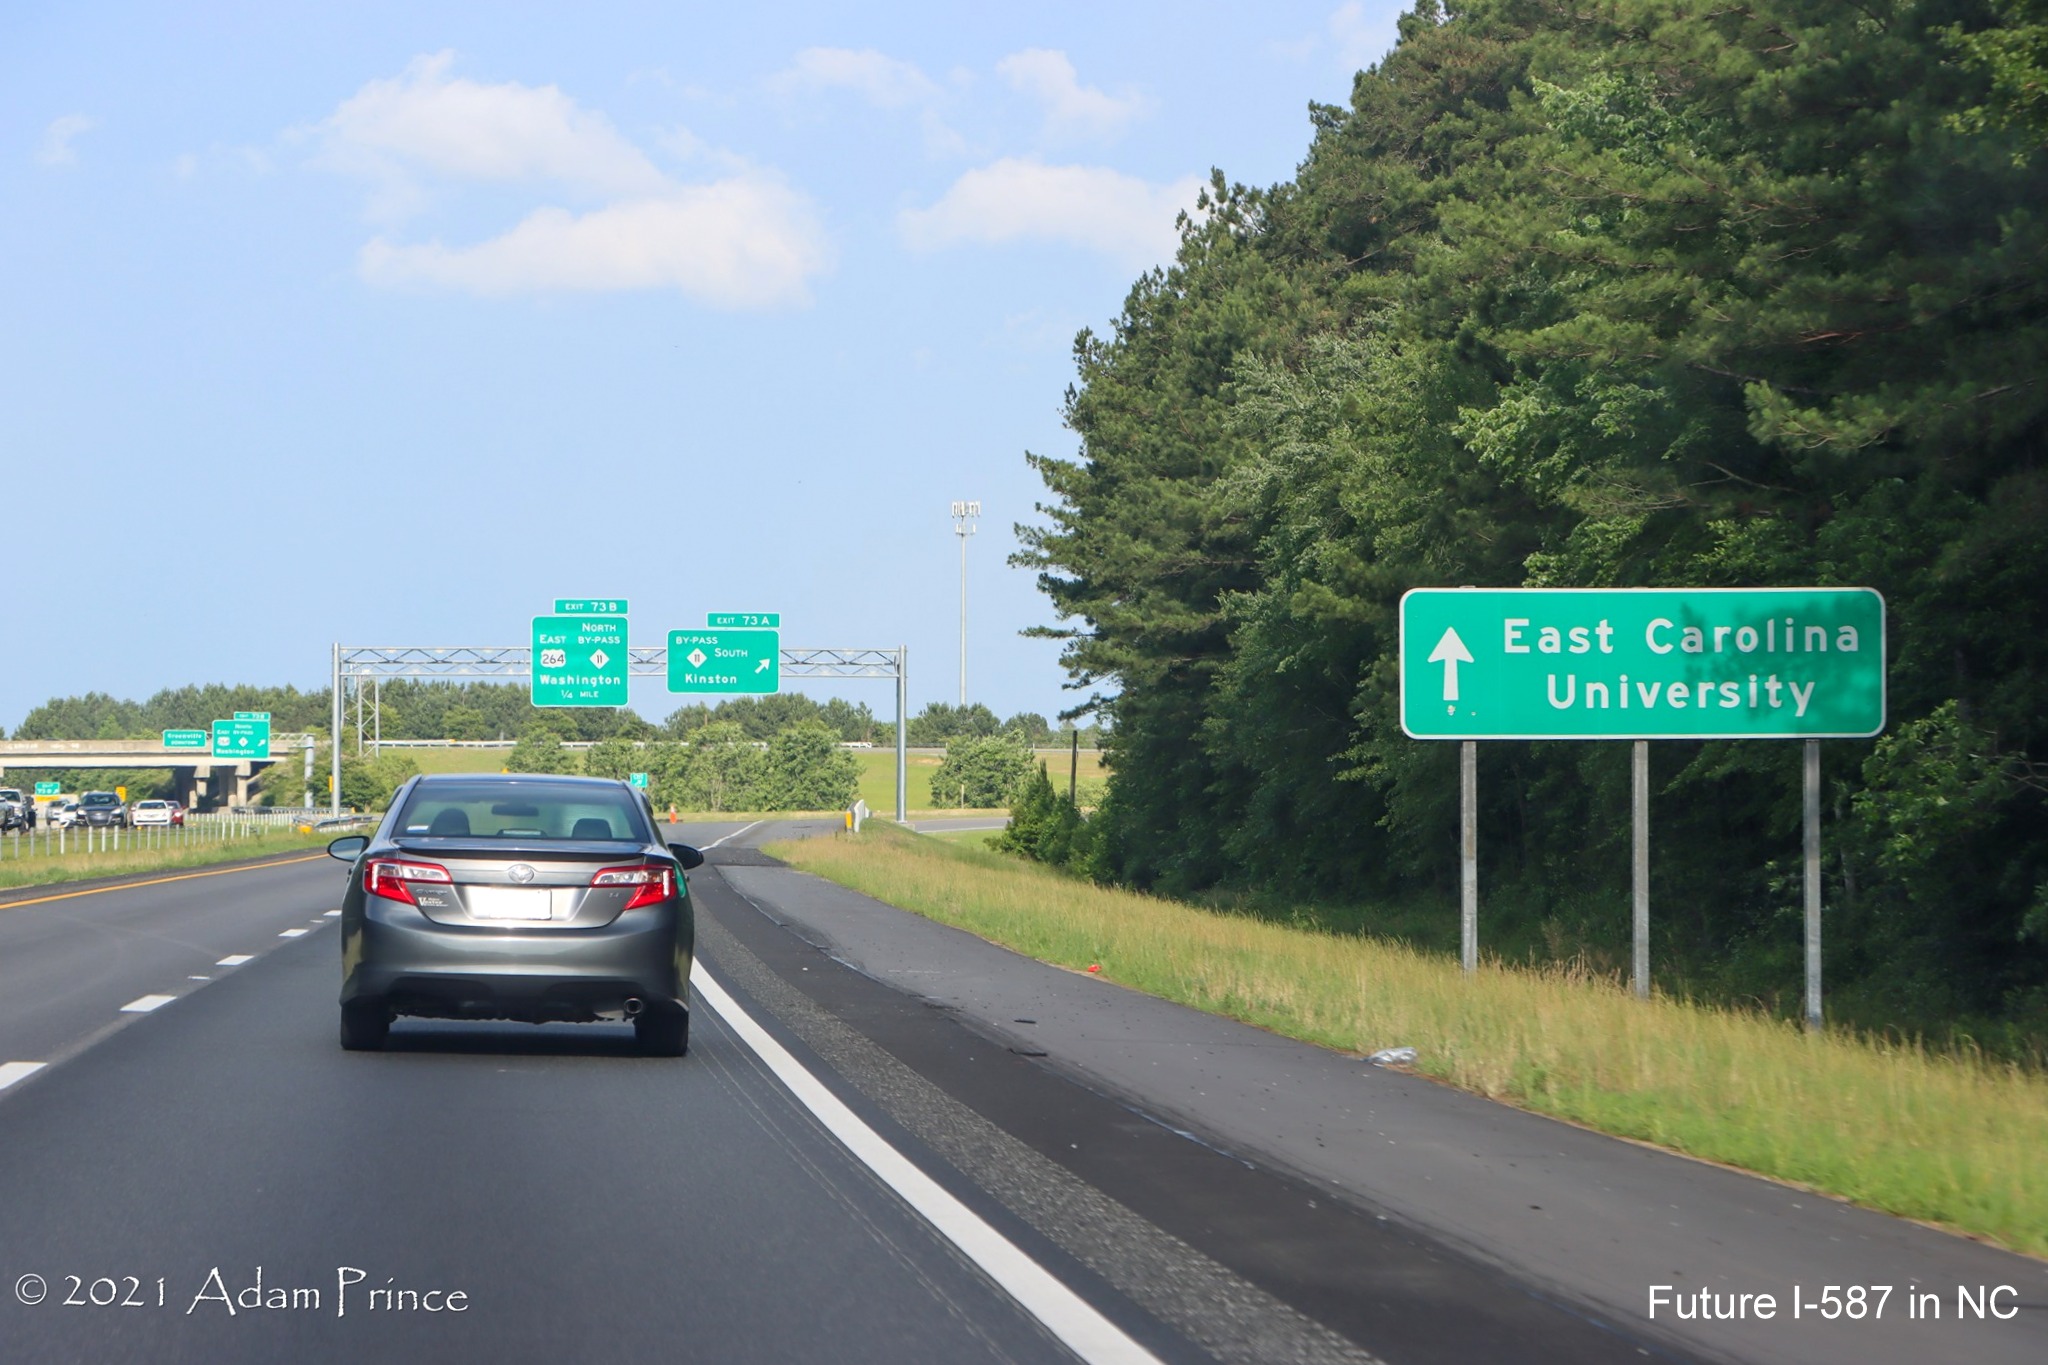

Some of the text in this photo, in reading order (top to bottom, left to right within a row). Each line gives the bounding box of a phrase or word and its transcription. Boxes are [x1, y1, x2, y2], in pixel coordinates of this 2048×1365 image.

[582, 623, 617, 632] NORTH
[540, 634, 620, 644] EAST BY-PASS
[676, 636, 718, 644] BY-PASS
[1504, 617, 1860, 655] East Carolina
[714, 648, 748, 657] SOUTH
[542, 654, 564, 664] 264
[596, 655, 603, 664] 11
[540, 674, 620, 687] Washington
[685, 674, 736, 684] Kinston
[1547, 674, 1815, 718] University
